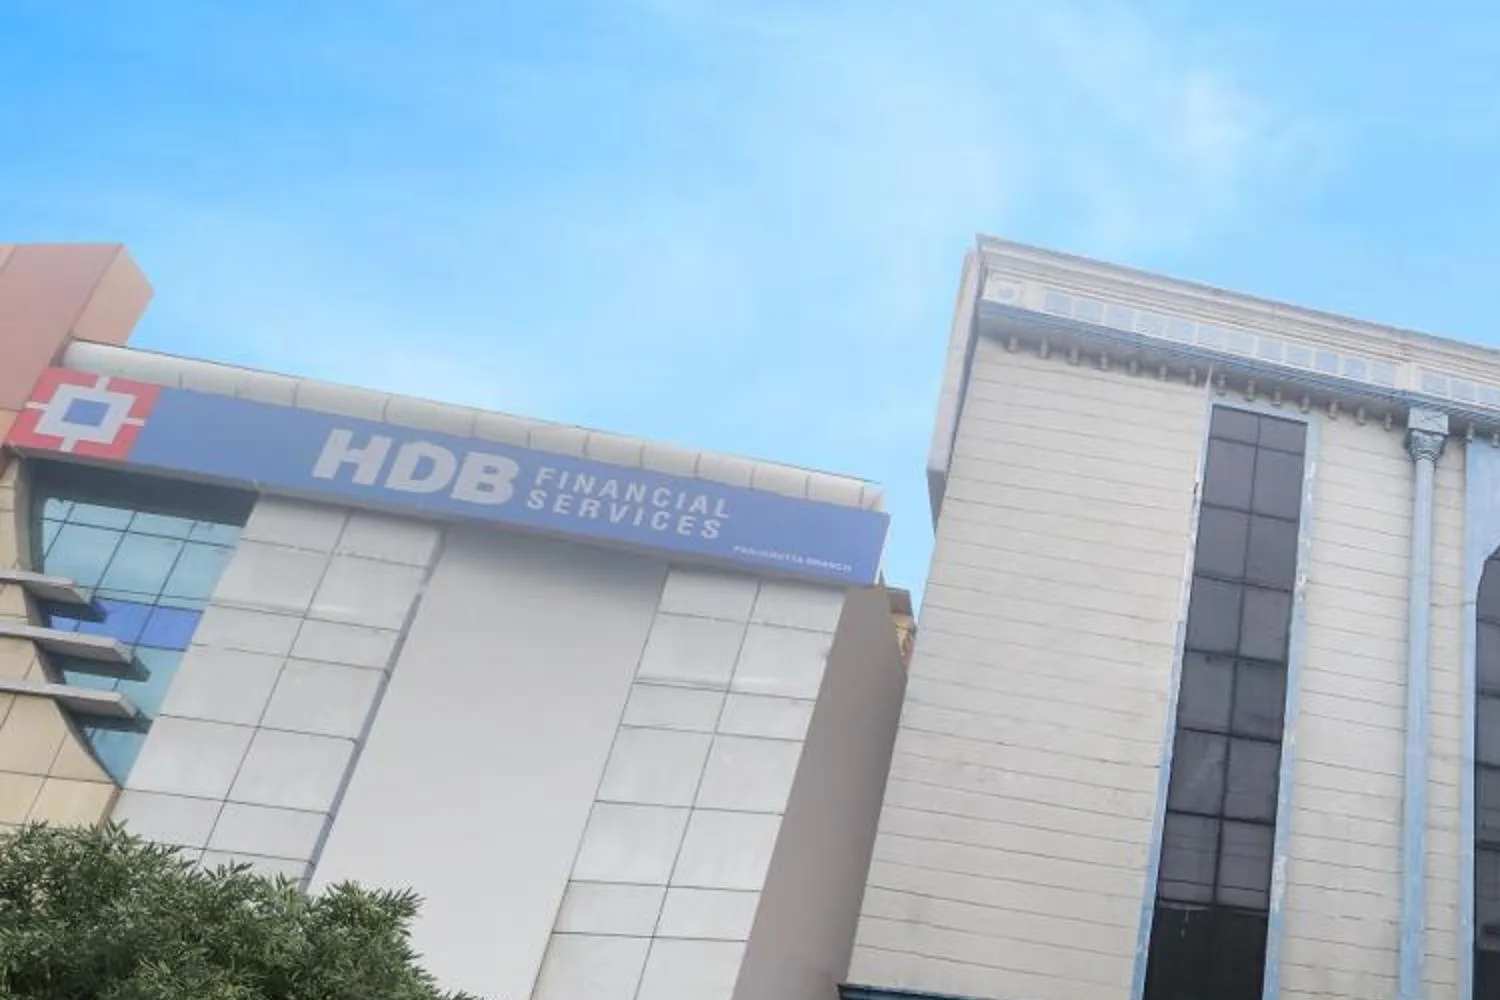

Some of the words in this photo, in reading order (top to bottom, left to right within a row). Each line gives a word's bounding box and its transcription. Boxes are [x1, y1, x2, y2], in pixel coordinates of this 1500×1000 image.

[312, 427, 520, 505] HDB
[534, 466, 731, 519] FINANCIAL
[526, 488, 722, 540] SERVICES
